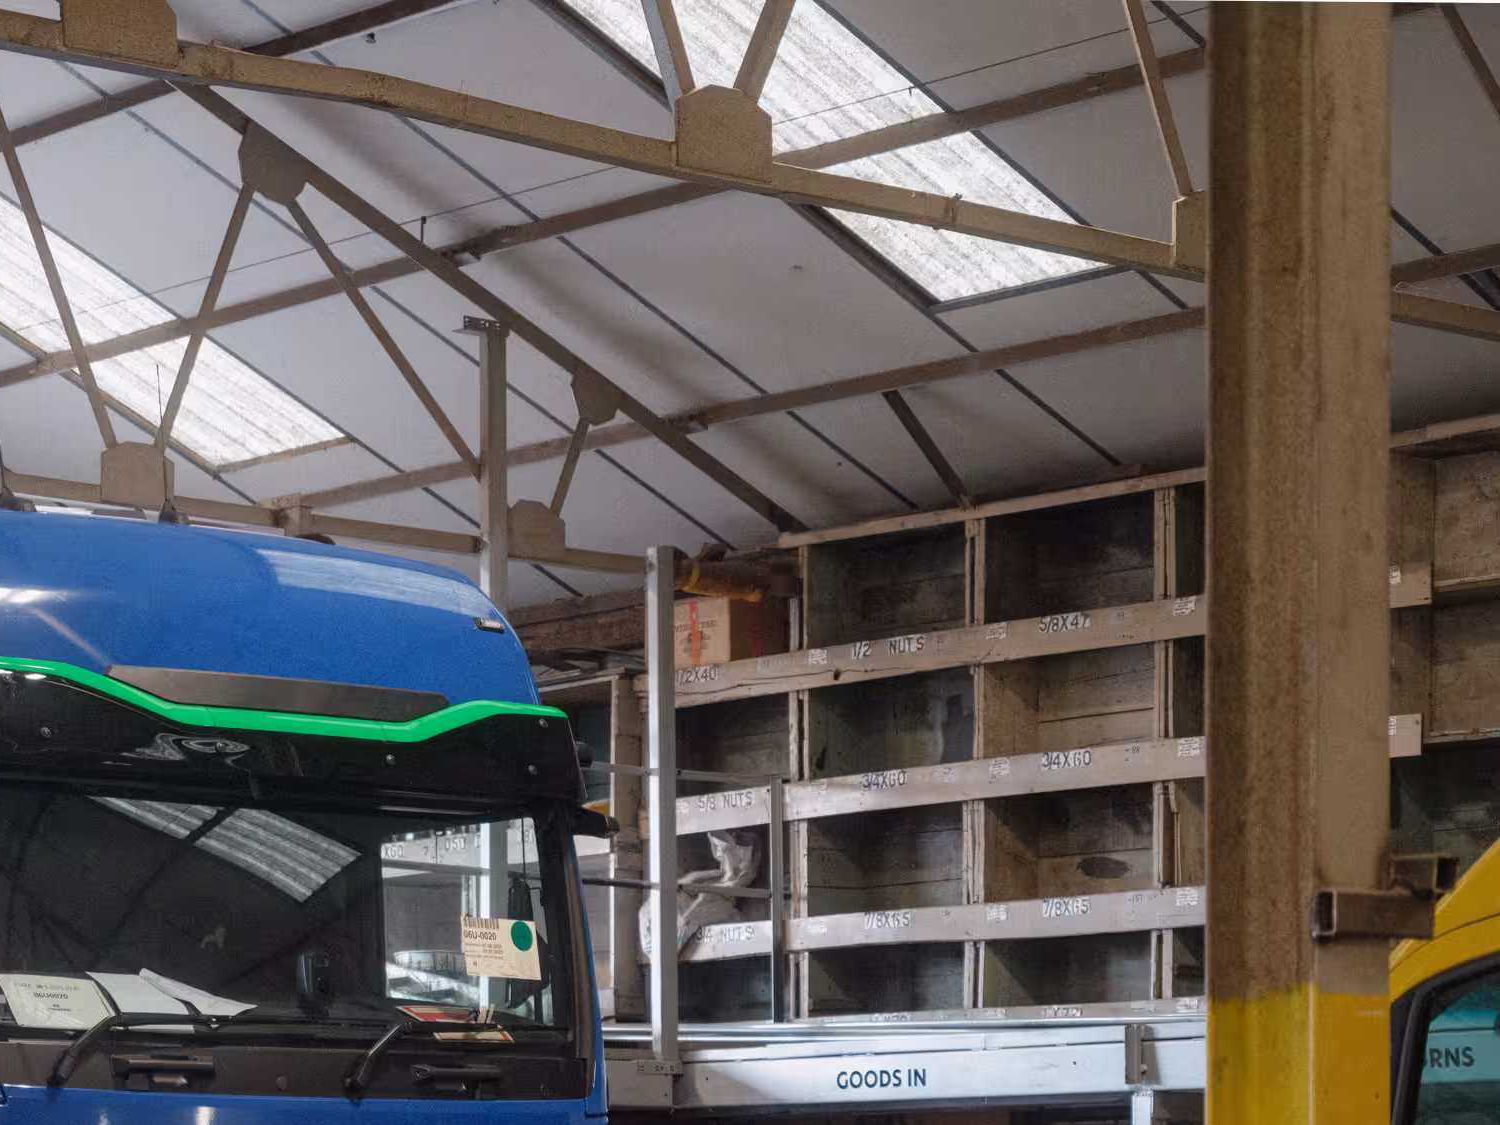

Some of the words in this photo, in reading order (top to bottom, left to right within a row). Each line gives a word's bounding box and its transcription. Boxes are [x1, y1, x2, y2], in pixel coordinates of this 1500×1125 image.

[852, 642, 872, 660] 1/2
[888, 636, 925, 655] NUTS
[722, 790, 753, 809] NUTS
[720, 925, 755, 943] NUTS
[1423, 1046, 1475, 1068] RNS
[836, 1069, 902, 1089] GOODS
[907, 1068, 927, 1087] IN
